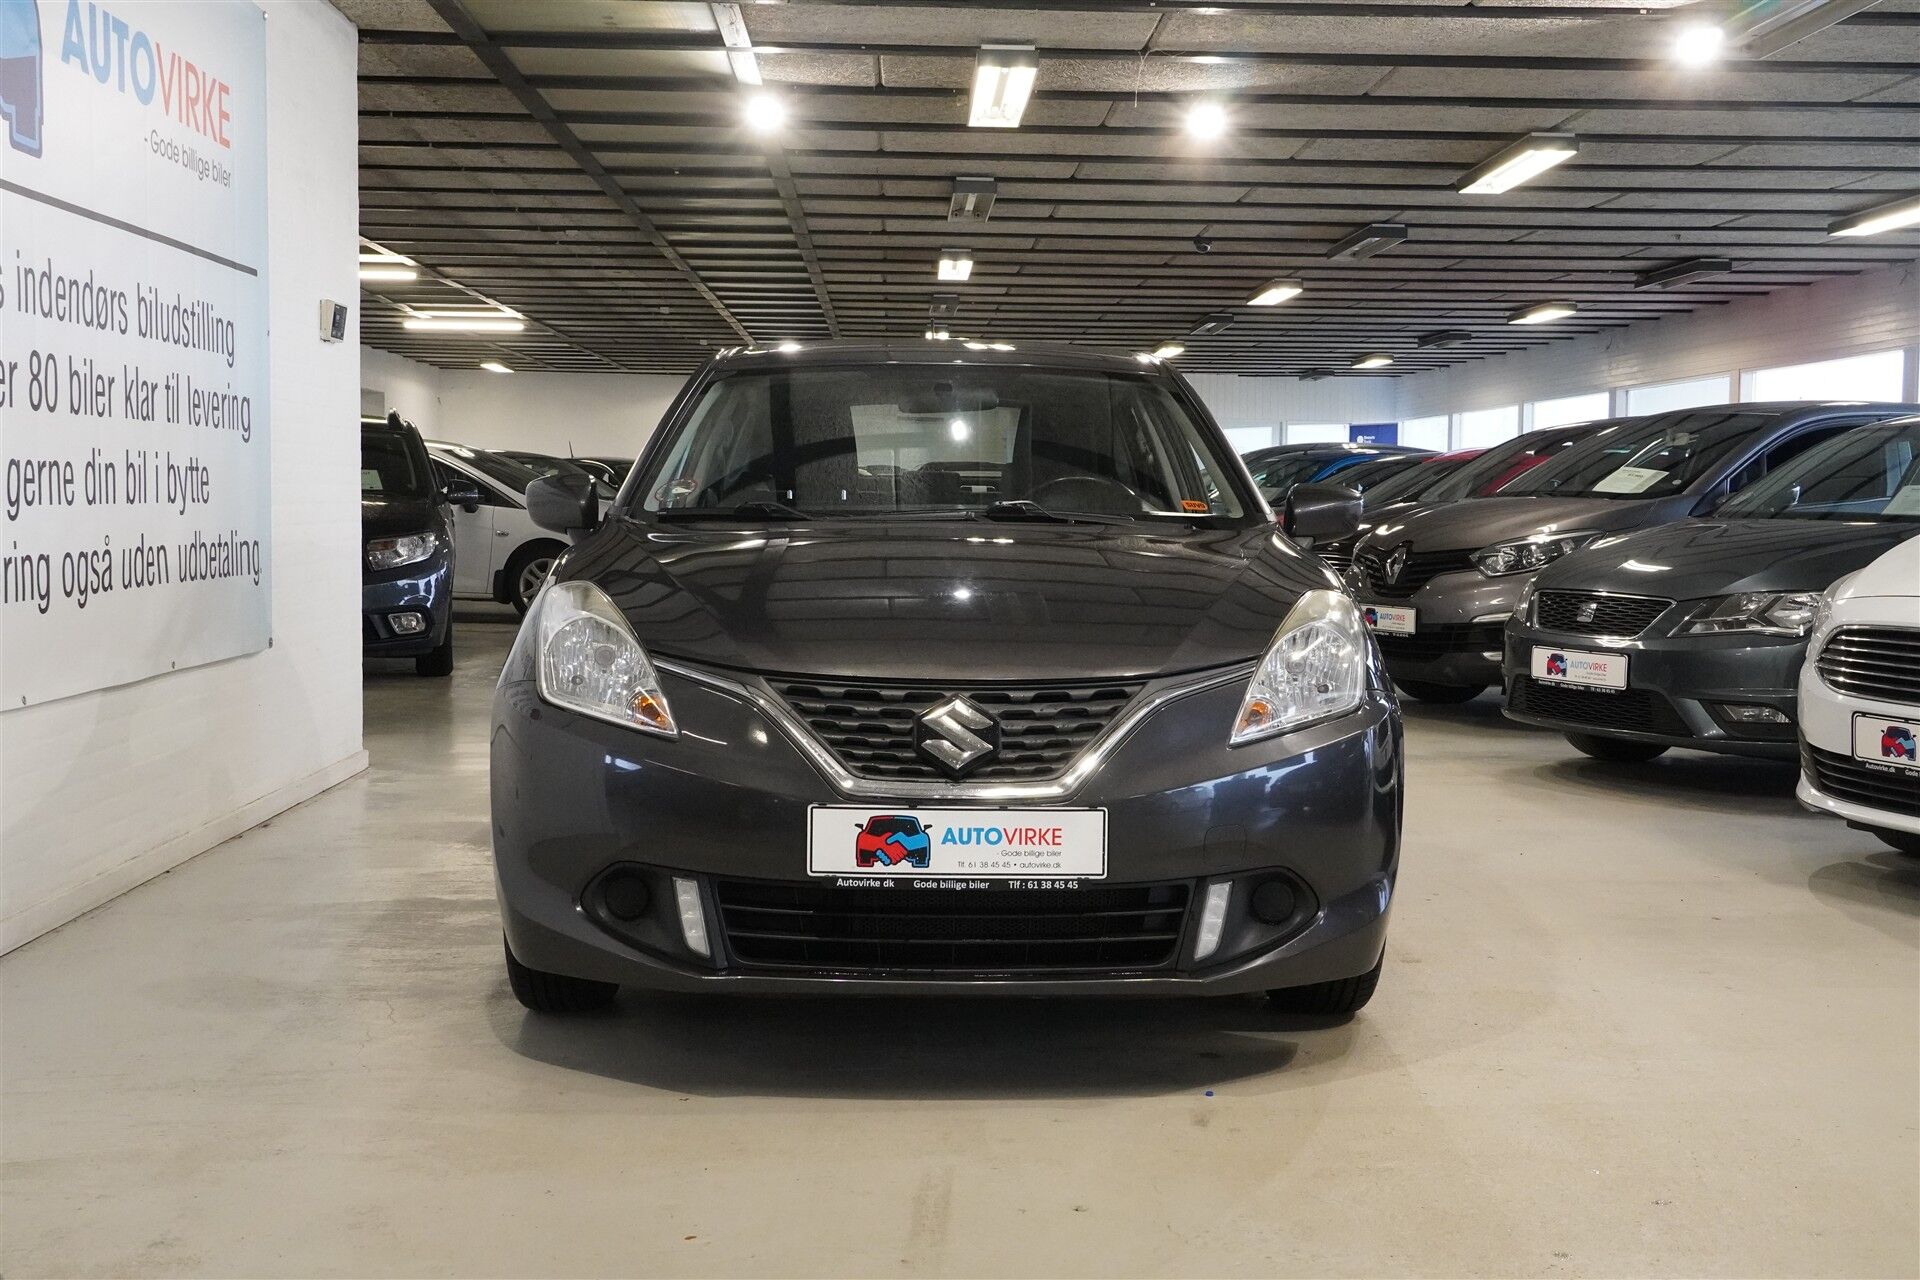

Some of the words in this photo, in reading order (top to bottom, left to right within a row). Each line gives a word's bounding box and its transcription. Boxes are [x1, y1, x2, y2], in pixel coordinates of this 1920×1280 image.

[60, 0, 231, 149] AUTOVIRKE
[150, 129, 180, 163] Gode
[182, 143, 210, 181] billige
[212, 159, 231, 188] biler
[16, 249, 128, 335] indendørs
[136, 282, 235, 368] biludstilling
[28, 349, 58, 413] 80
[68, 354, 115, 418] biler
[123, 364, 159, 422] klar
[164, 372, 180, 424] til
[187, 374, 251, 443] levering
[6, 457, 75, 521] gerne
[84, 447, 116, 506] din
[125, 448, 147, 505] bil
[155, 450, 159, 504] i
[166, 450, 210, 516] bytte
[3, 540, 51, 615] ring
[61, 534, 113, 609] også
[121, 532, 170, 590] uden
[1570, 660, 1608, 673] AUTOVIRKE
[940, 827, 1063, 846] AUTOVIRKE
[967, 861, 977, 869] 61
[979, 861, 989, 869] 38
[990, 861, 1000, 869] 45
[1001, 861, 1011, 869] 45
[1000, 849, 1022, 857] Gode
[1023, 849, 1045, 859] billige
[1046, 849, 1062, 857] biler
[913, 880, 938, 889] Gode
[939, 880, 967, 891] billige
[968, 880, 990, 889] biler
[1008, 880, 1021, 889] Tlf
[1027, 880, 1039, 889] 61
[1040, 880, 1052, 889] 38
[1053, 880, 1065, 889] 45
[1066, 880, 1079, 889] 45
